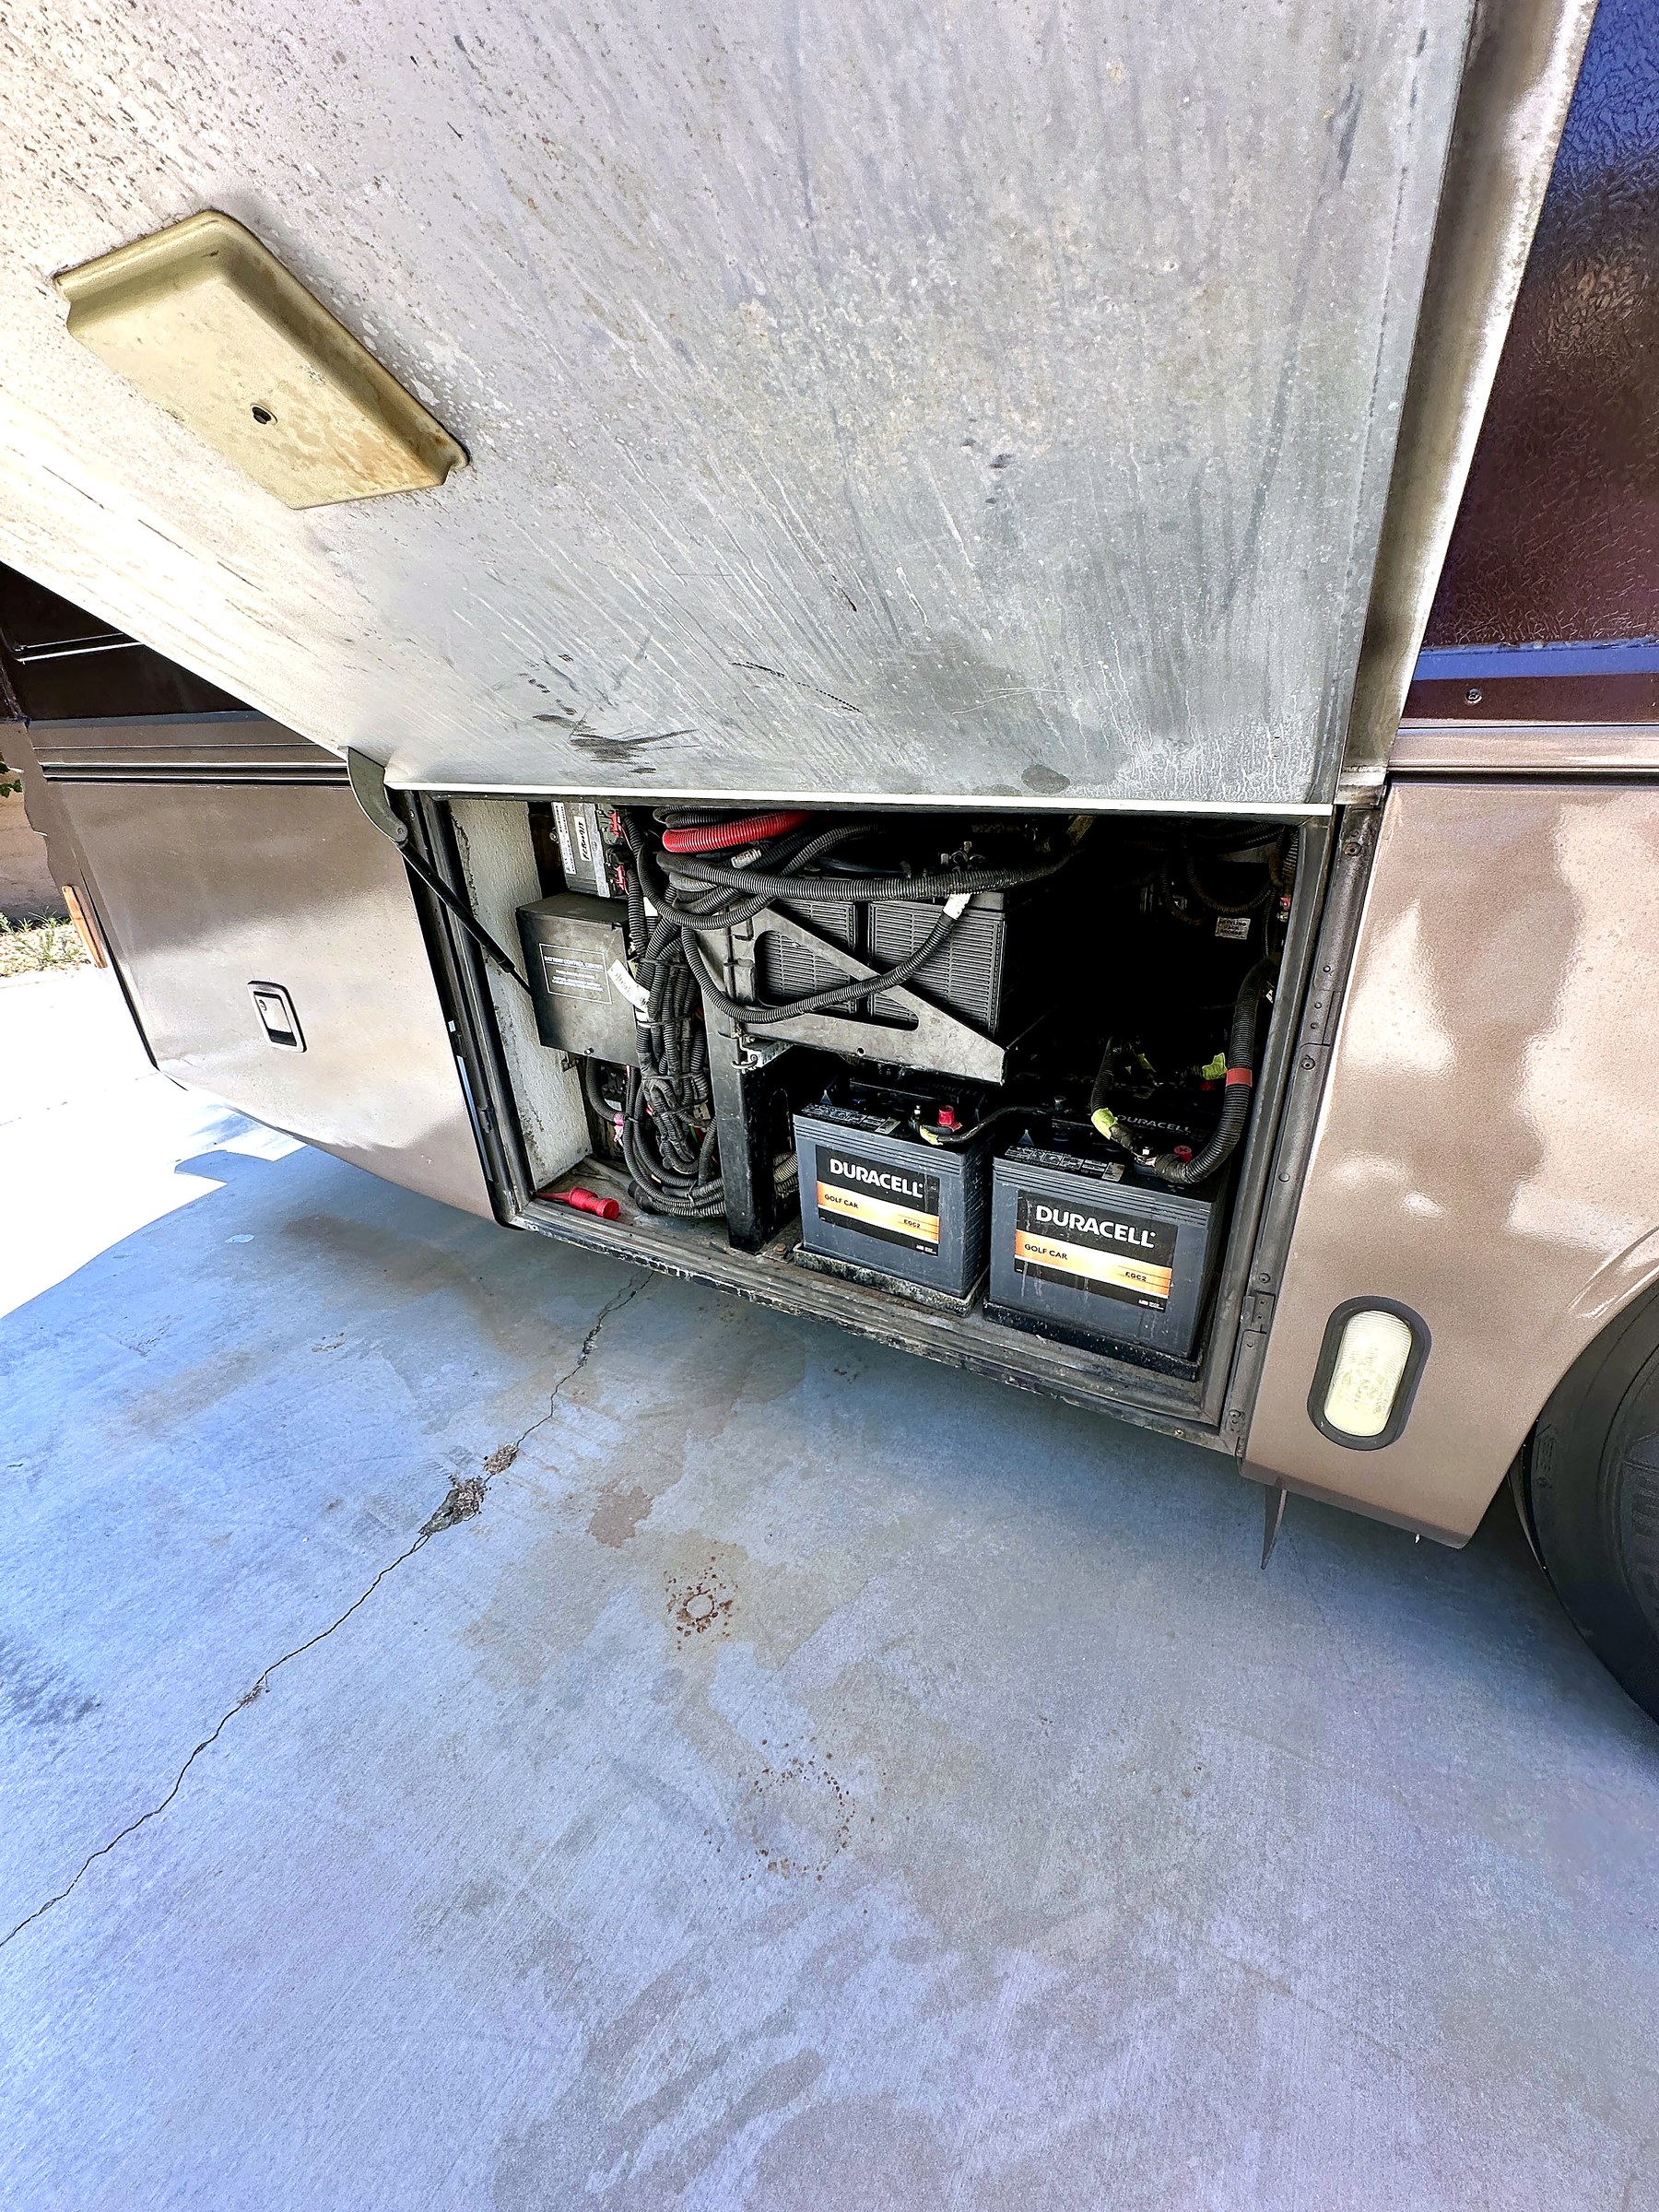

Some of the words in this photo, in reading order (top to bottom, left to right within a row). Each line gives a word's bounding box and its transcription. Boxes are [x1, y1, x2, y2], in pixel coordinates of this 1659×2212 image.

[830, 1158, 924, 1199] DURACELL
[824, 1194, 842, 1204] GOLF
[843, 1199, 859, 1209] CAR
[1036, 1205, 1157, 1249] DURACELL
[1024, 1243, 1047, 1254] GOLF
[1049, 1250, 1068, 1261] CAR
